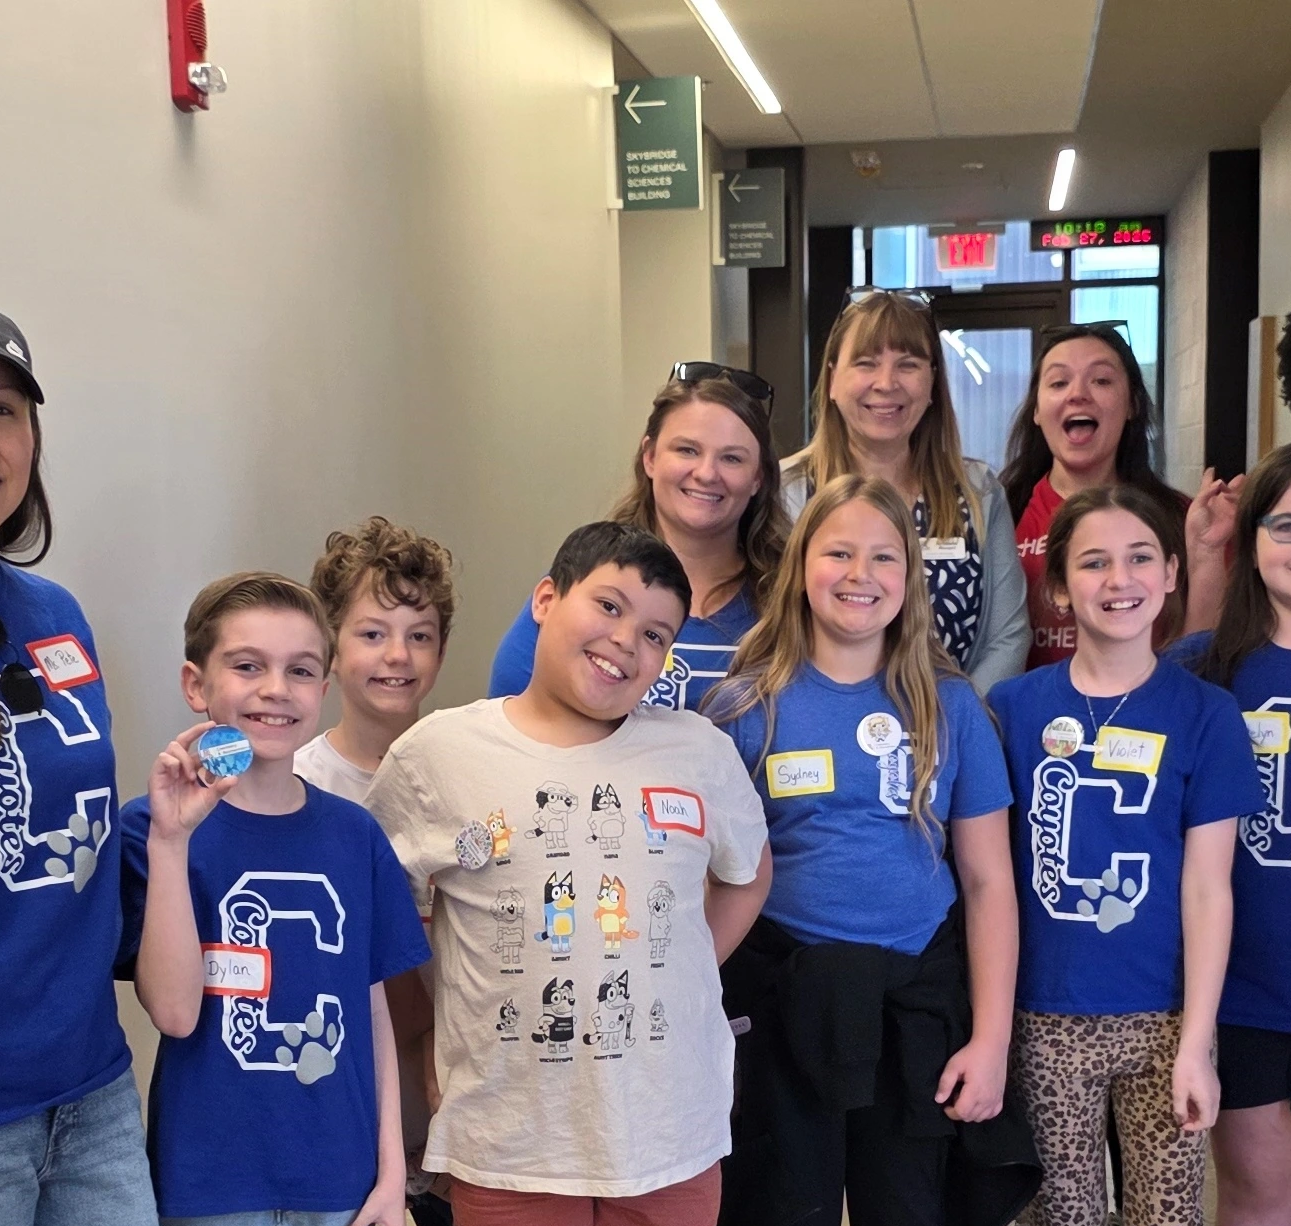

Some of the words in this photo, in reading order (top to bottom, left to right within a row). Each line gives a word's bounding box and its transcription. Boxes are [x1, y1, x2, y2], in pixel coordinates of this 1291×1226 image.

[627, 164, 640, 174] TO
[641, 162, 688, 174] CHEMICAL
[627, 176, 672, 187] SCIENCES
[628, 190, 671, 201] BUILDING
[1035, 626, 1077, 648] CHE
[1109, 739, 1145, 759] Violet
[778, 764, 819, 786] Sydney
[661, 799, 690, 818] Noah
[1028, 756, 1079, 904] Coyotes
[208, 959, 251, 983] Dylan
